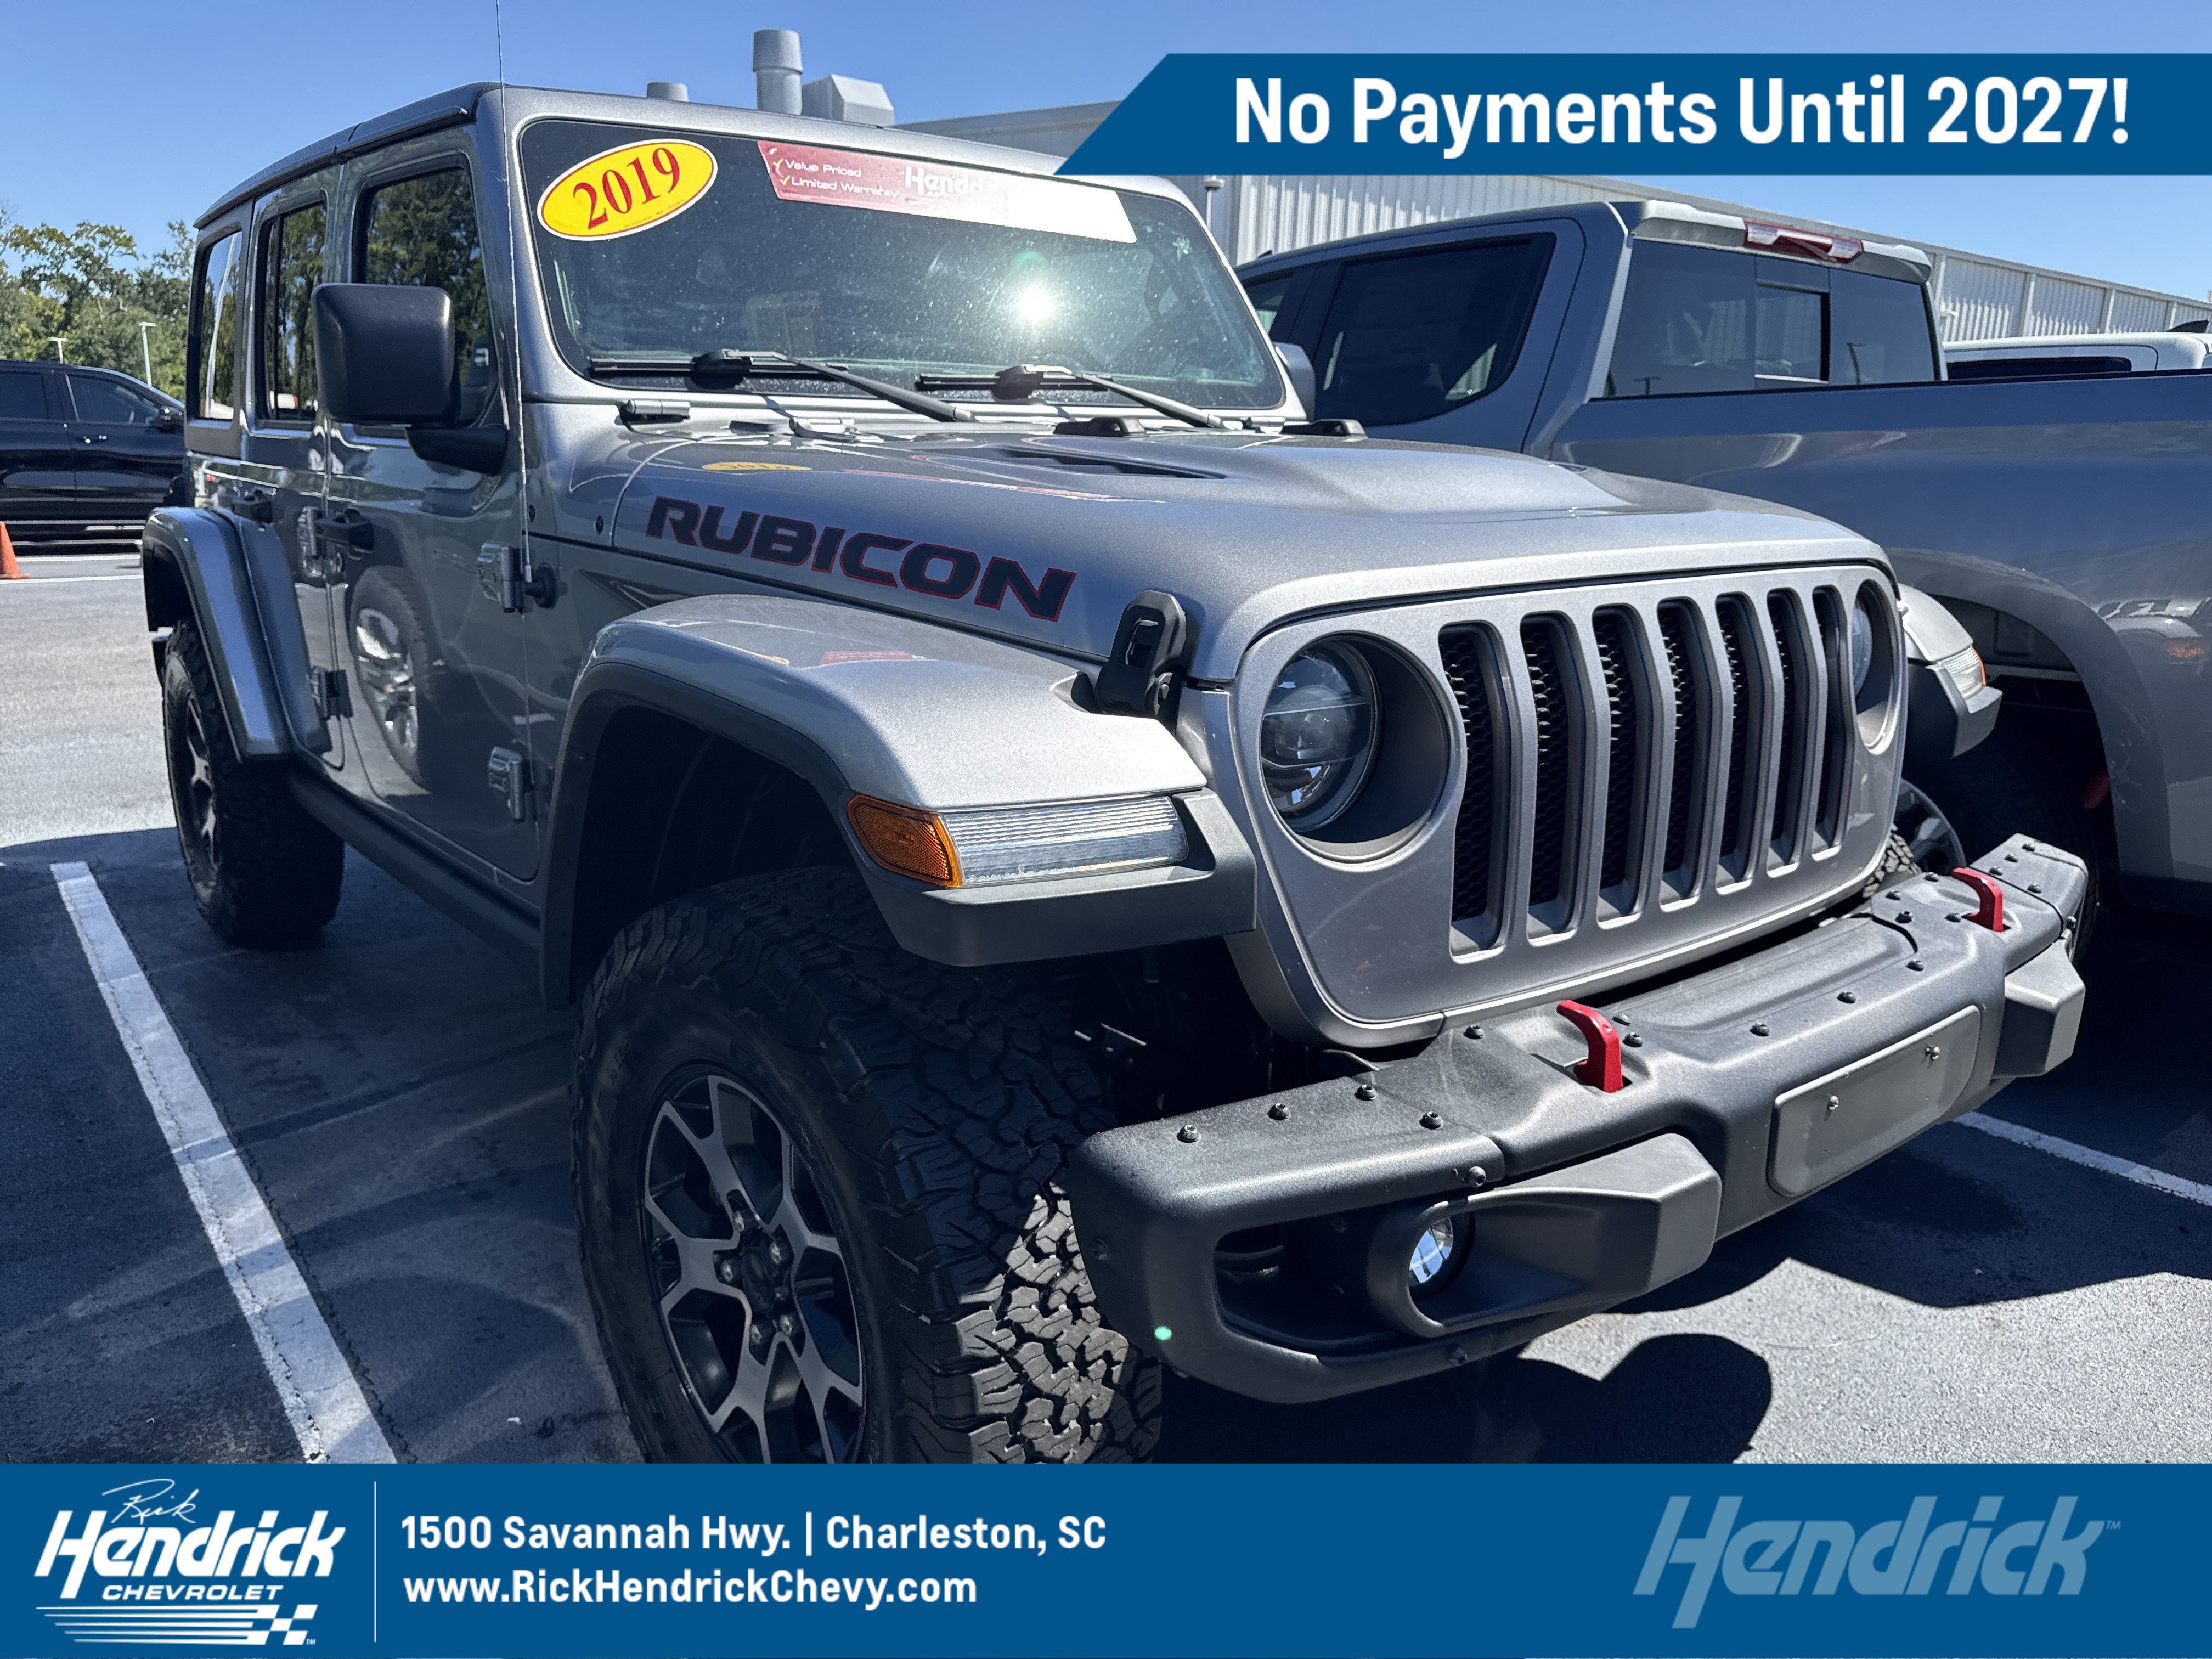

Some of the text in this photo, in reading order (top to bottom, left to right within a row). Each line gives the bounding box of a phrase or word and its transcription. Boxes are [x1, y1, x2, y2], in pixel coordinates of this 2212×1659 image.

[573, 148, 680, 230] 2019
[785, 159, 862, 177] Value Priced
[791, 176, 899, 199] Limited Warranty
[645, 496, 1078, 622] RUBICON
